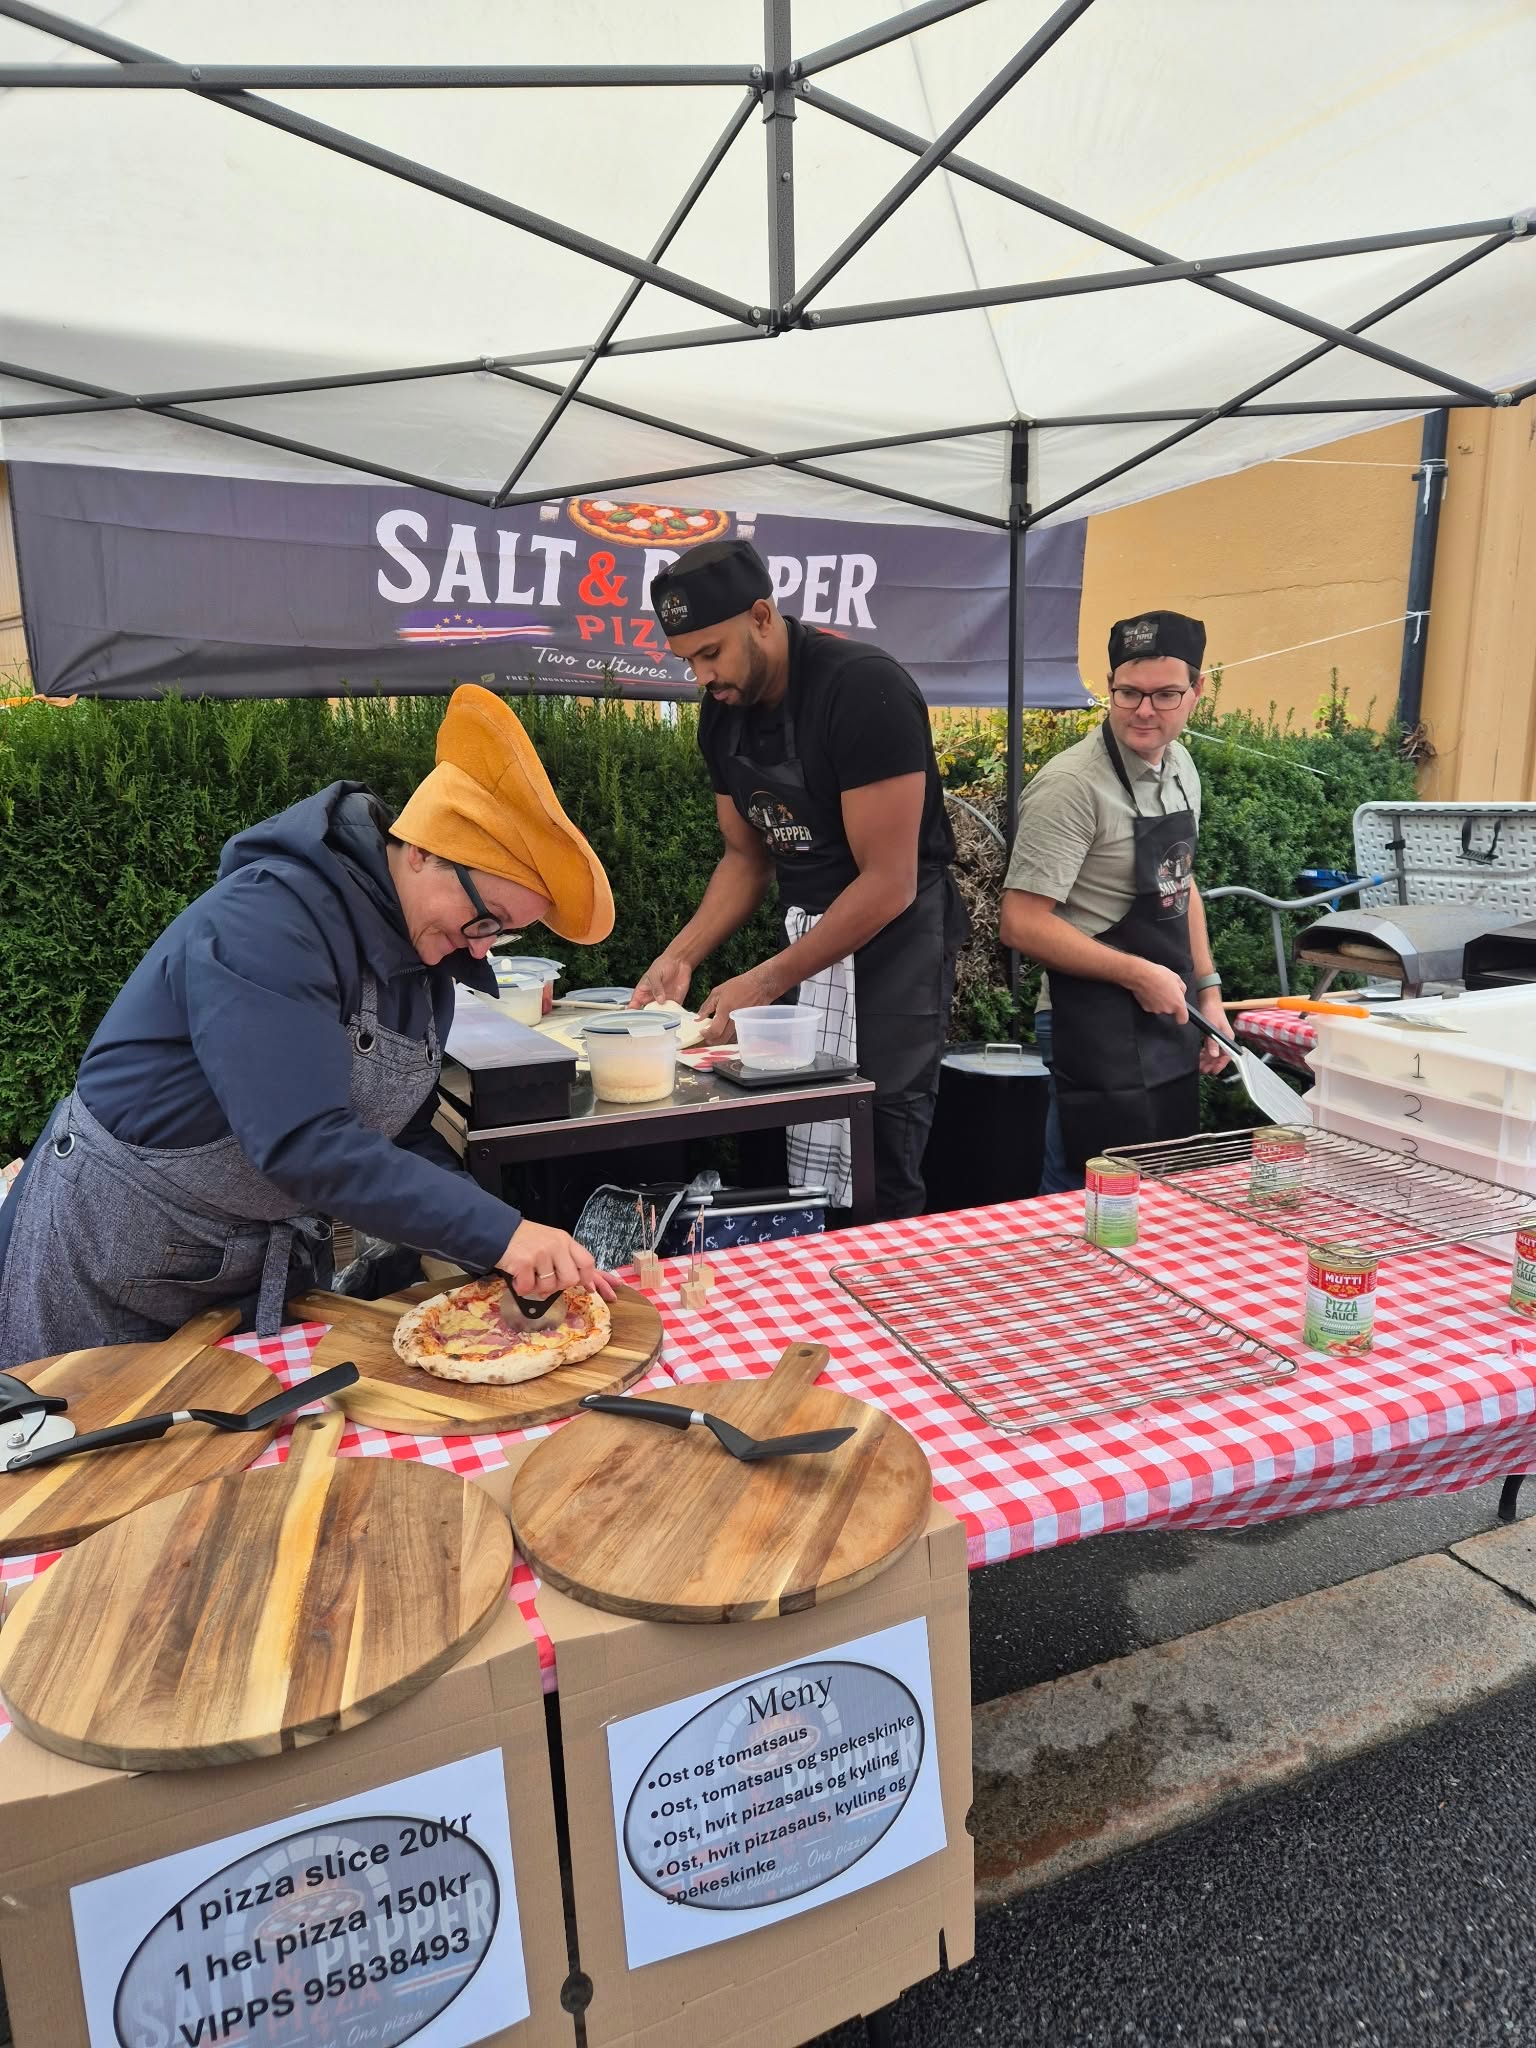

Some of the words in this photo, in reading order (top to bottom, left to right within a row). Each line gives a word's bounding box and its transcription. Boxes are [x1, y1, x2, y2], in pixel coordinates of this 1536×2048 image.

[376, 509, 577, 606] SALT
[578, 550, 628, 607] &
[640, 548, 878, 630] PPER
[576, 614, 671, 651] PIZ
[531, 646, 578, 666] Two
[586, 655, 672, 680] cultures.
[772, 825, 813, 842] PEPPER
[1412, 1053, 1426, 1079] 1
[1403, 1094, 1424, 1123] 2
[1325, 1272, 1362, 1286] MUTTI
[1517, 1269, 1536, 1284] SAUC
[1325, 1296, 1358, 1313] PIZZA
[1325, 1309, 1358, 1322] SAUCE
[746, 1676, 833, 1726] Meny
[658, 1767, 690, 1788] Ost
[694, 1759, 716, 1777] og
[718, 1727, 808, 1768] tomatsaus
[660, 1797, 698, 1817] Ost,
[701, 1763, 794, 1804] tomatsaus
[797, 1753, 817, 1770] og
[820, 1715, 915, 1762] spekeskinke
[663, 1826, 701, 1847] Ost,
[705, 1811, 738, 1834] hvit
[741, 1783, 824, 1824] pizzasaus
[827, 1771, 847, 1788] og
[849, 1749, 900, 1781] kylling
[666, 1856, 704, 1876] Ost,
[708, 1840, 741, 1863] hvit
[744, 1811, 832, 1854] pizzasaus,
[835, 1785, 887, 1817] kylling
[889, 1775, 907, 1793] og
[168, 1902, 184, 1931] 1
[200, 1874, 295, 1931] pizza
[305, 1842, 390, 1887] slice
[399, 1812, 472, 1857] 20kr
[666, 1859, 776, 1906] spekeskinke
[175, 1962, 191, 1990] 1
[206, 1938, 267, 1982] hel
[276, 1909, 367, 1965] pizza
[377, 1871, 471, 1920] 150kr
[179, 1988, 295, 2048] VIPPS
[303, 1927, 470, 2006] 95838493
